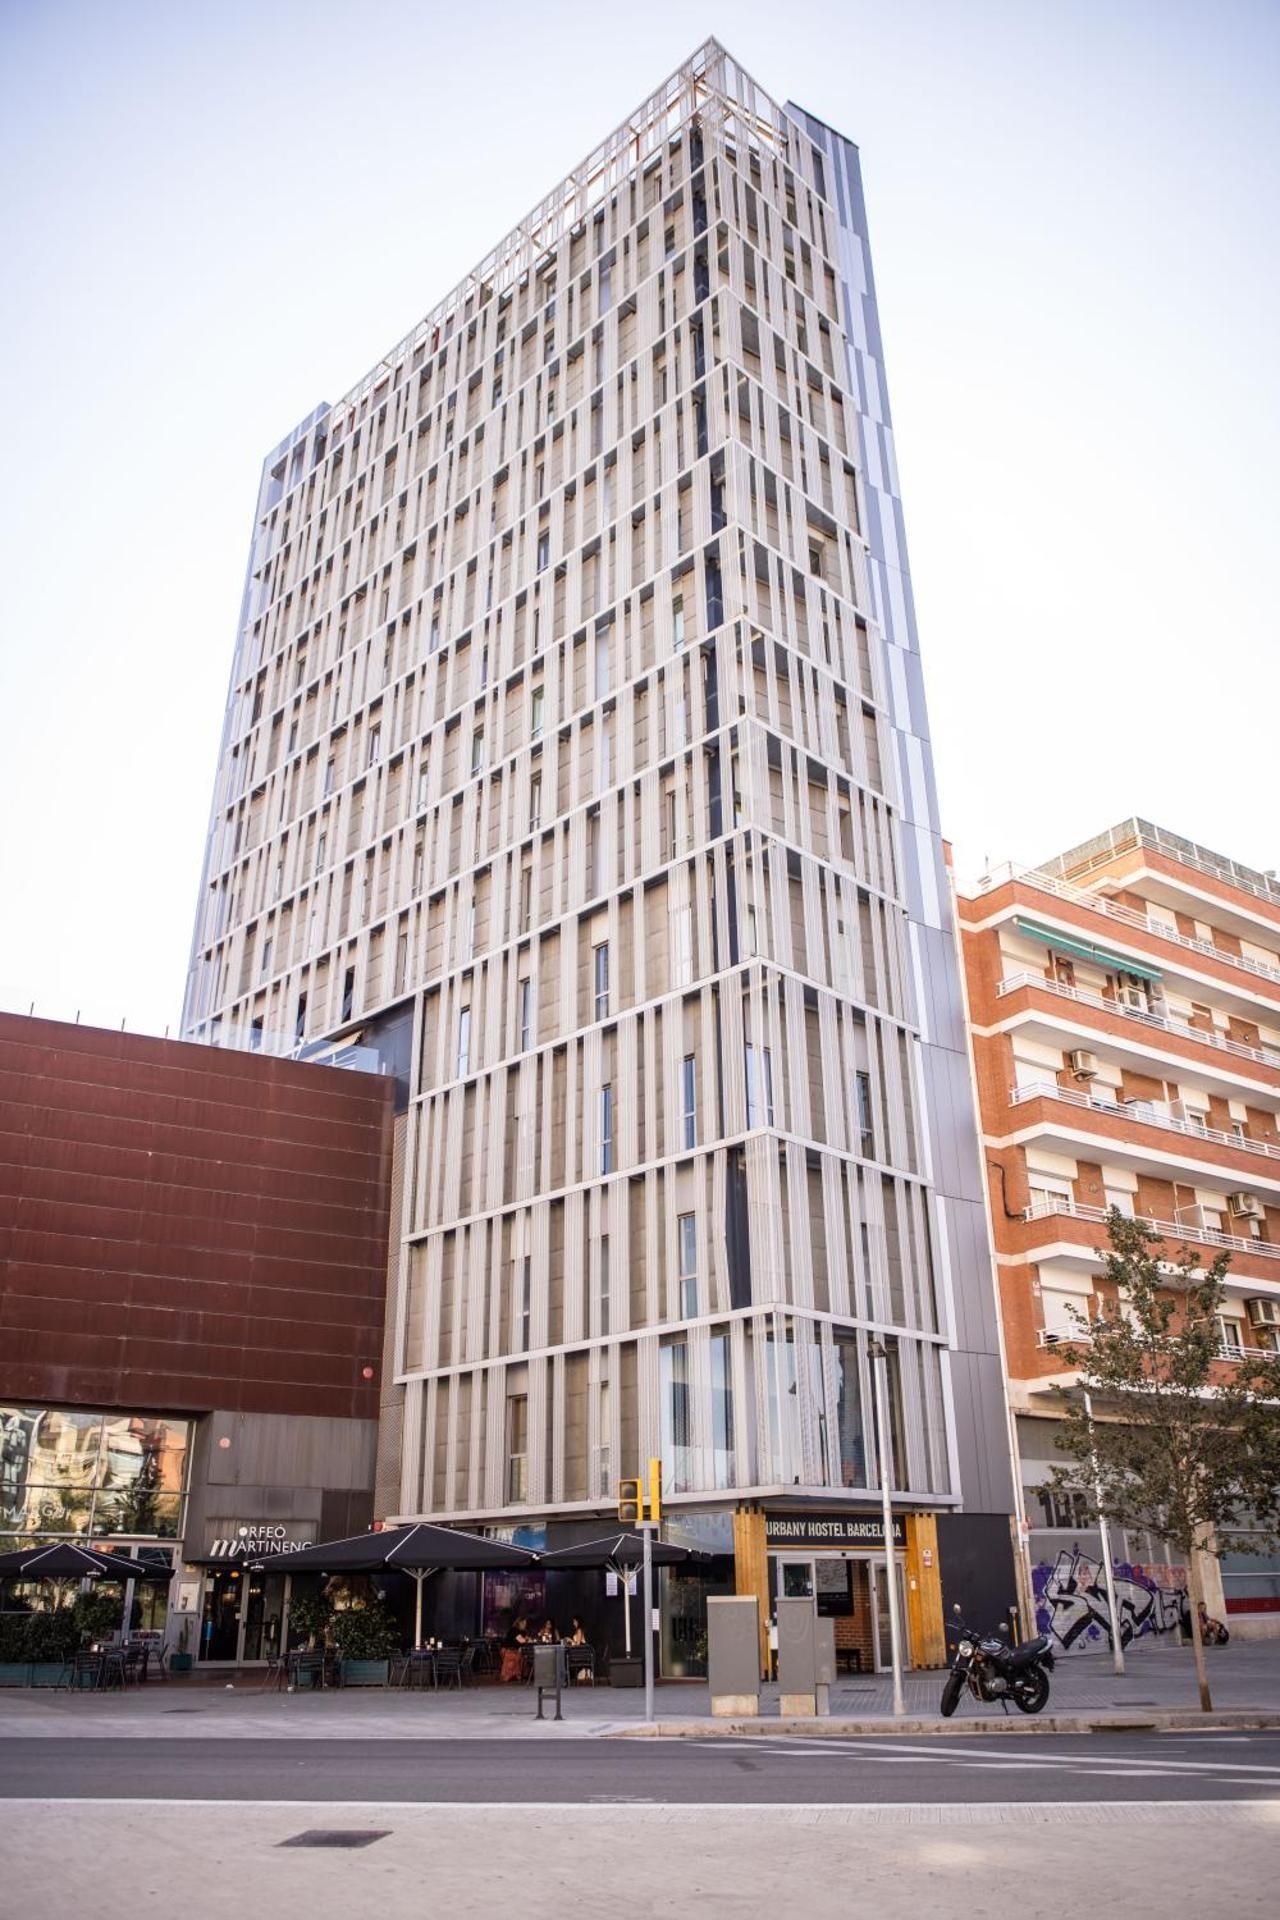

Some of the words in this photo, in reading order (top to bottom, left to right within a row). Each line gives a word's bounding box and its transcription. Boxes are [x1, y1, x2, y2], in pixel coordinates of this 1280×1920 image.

[766, 1521, 806, 1536] URBANY
[808, 1522, 846, 1537] HOSTEL
[847, 1522, 901, 1537] BARCELA
